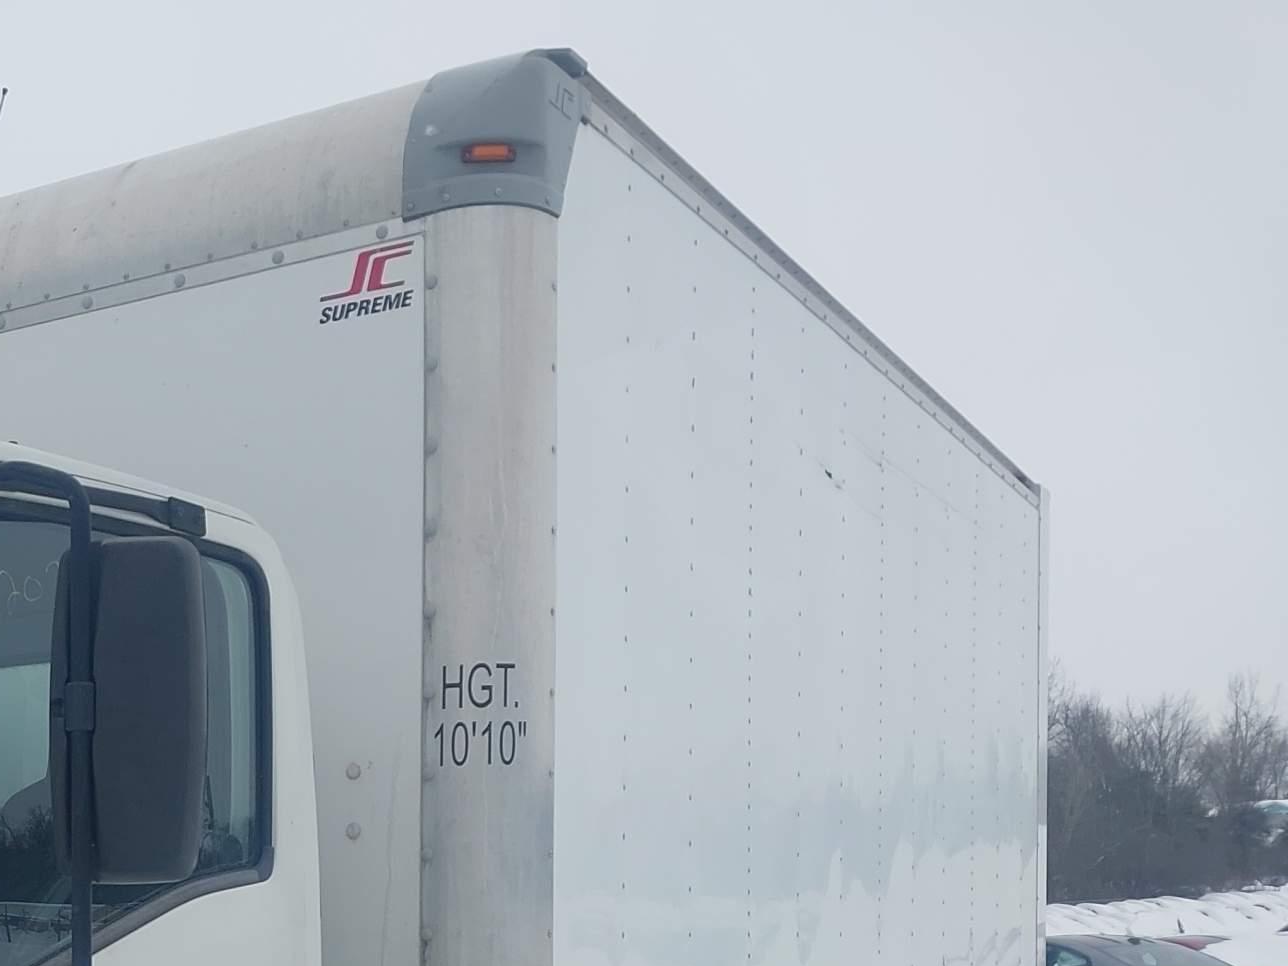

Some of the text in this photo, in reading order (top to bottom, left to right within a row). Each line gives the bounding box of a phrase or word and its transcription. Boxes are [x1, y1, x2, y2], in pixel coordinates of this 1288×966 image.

[319, 289, 414, 324] SUPREME
[441, 662, 519, 710] HGT.
[434, 720, 527, 767] 10'10"
